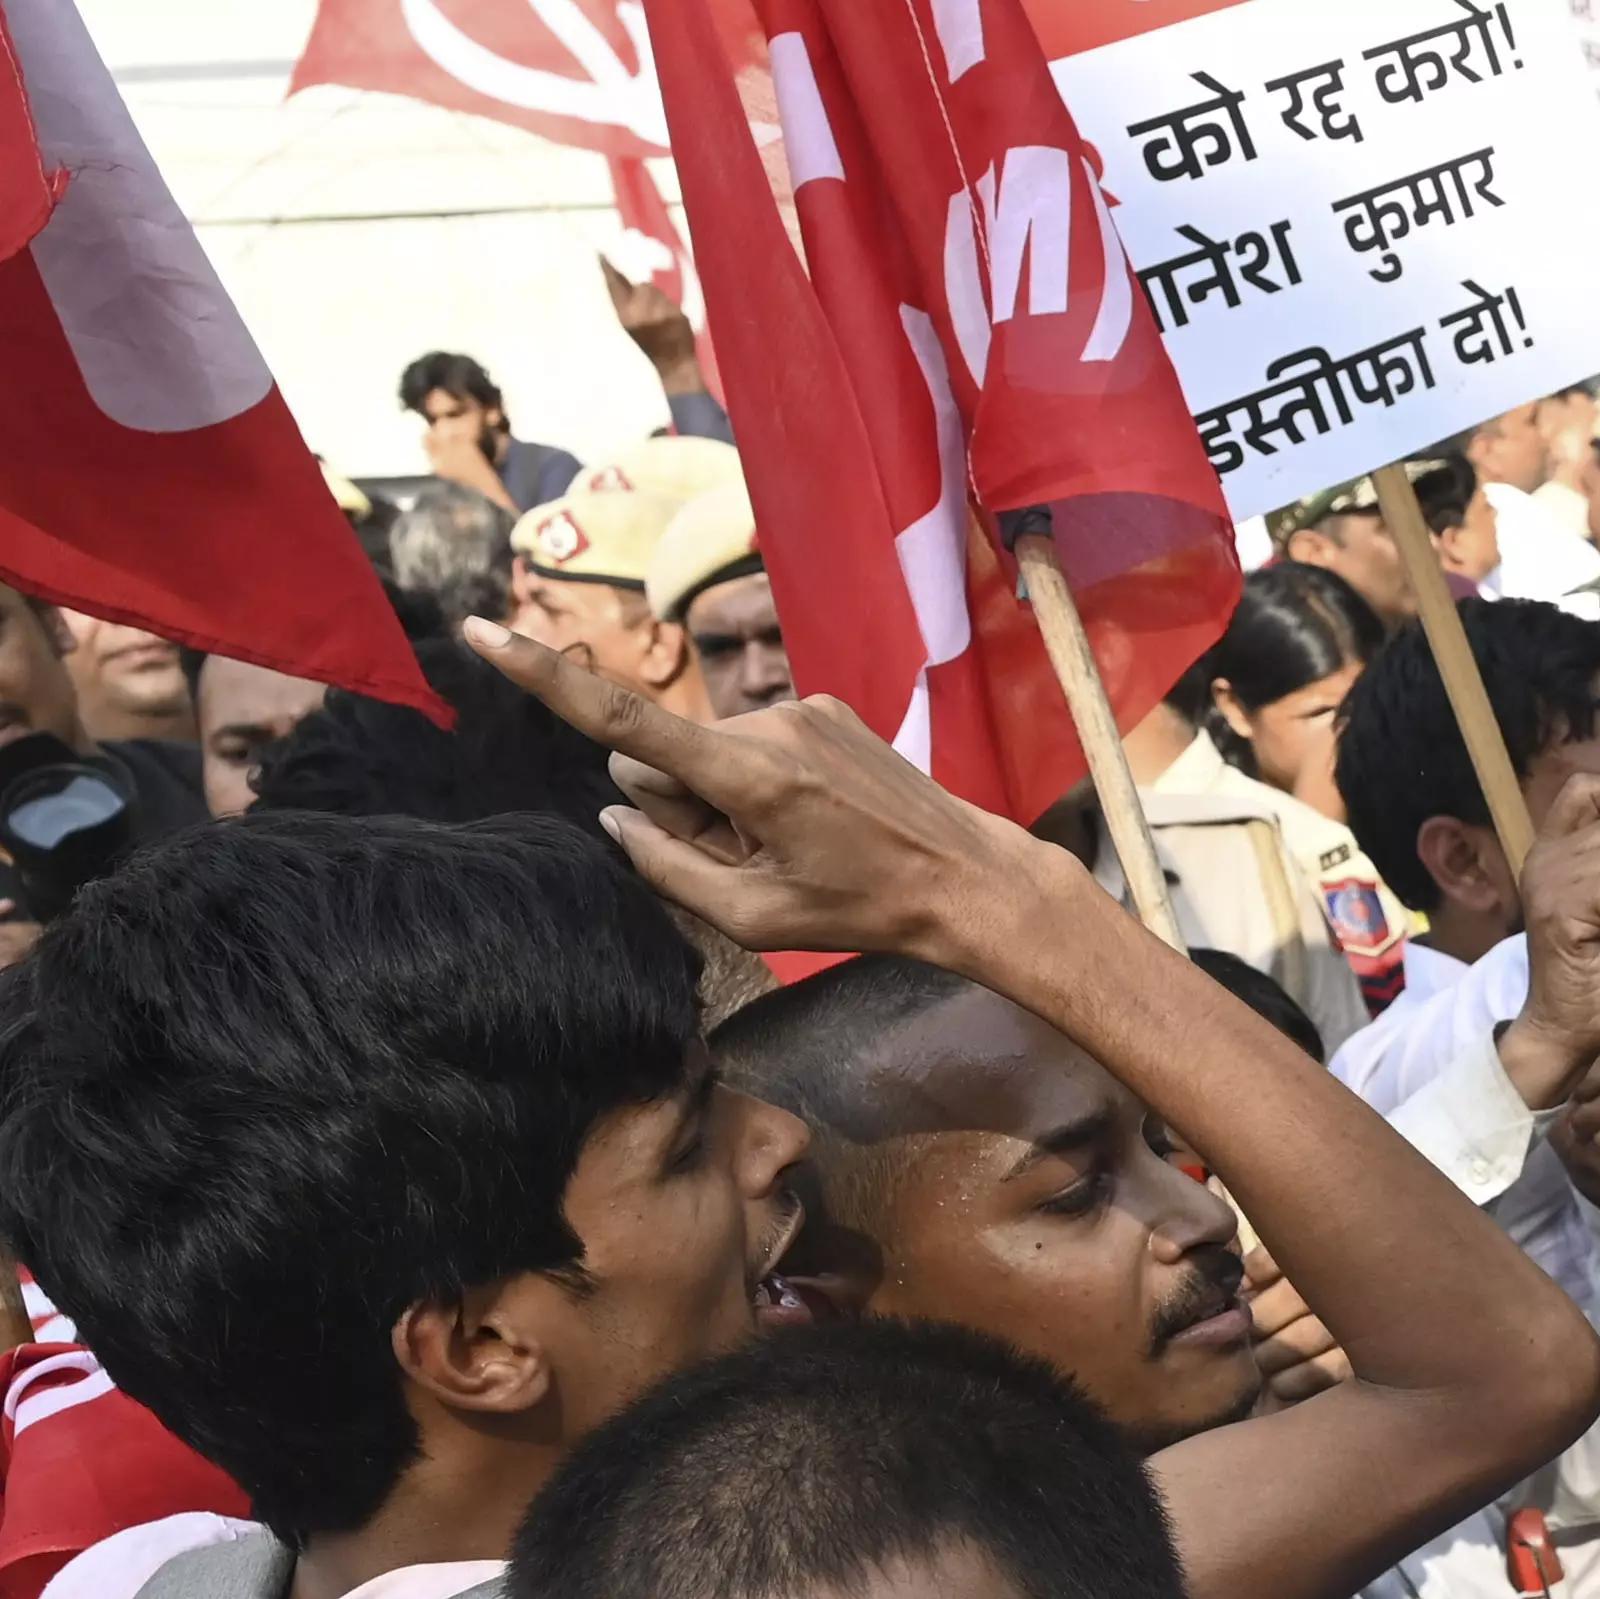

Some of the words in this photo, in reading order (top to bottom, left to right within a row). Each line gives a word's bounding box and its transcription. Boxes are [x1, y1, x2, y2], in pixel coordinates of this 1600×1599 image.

[1127, 70, 1257, 182] को
[1264, 58, 1364, 143] रद्द
[1362, 0, 1524, 104] करो!
[1135, 220, 1302, 334] ानेश
[1331, 146, 1506, 283] कुमार
[1439, 279, 1534, 364] दो!
